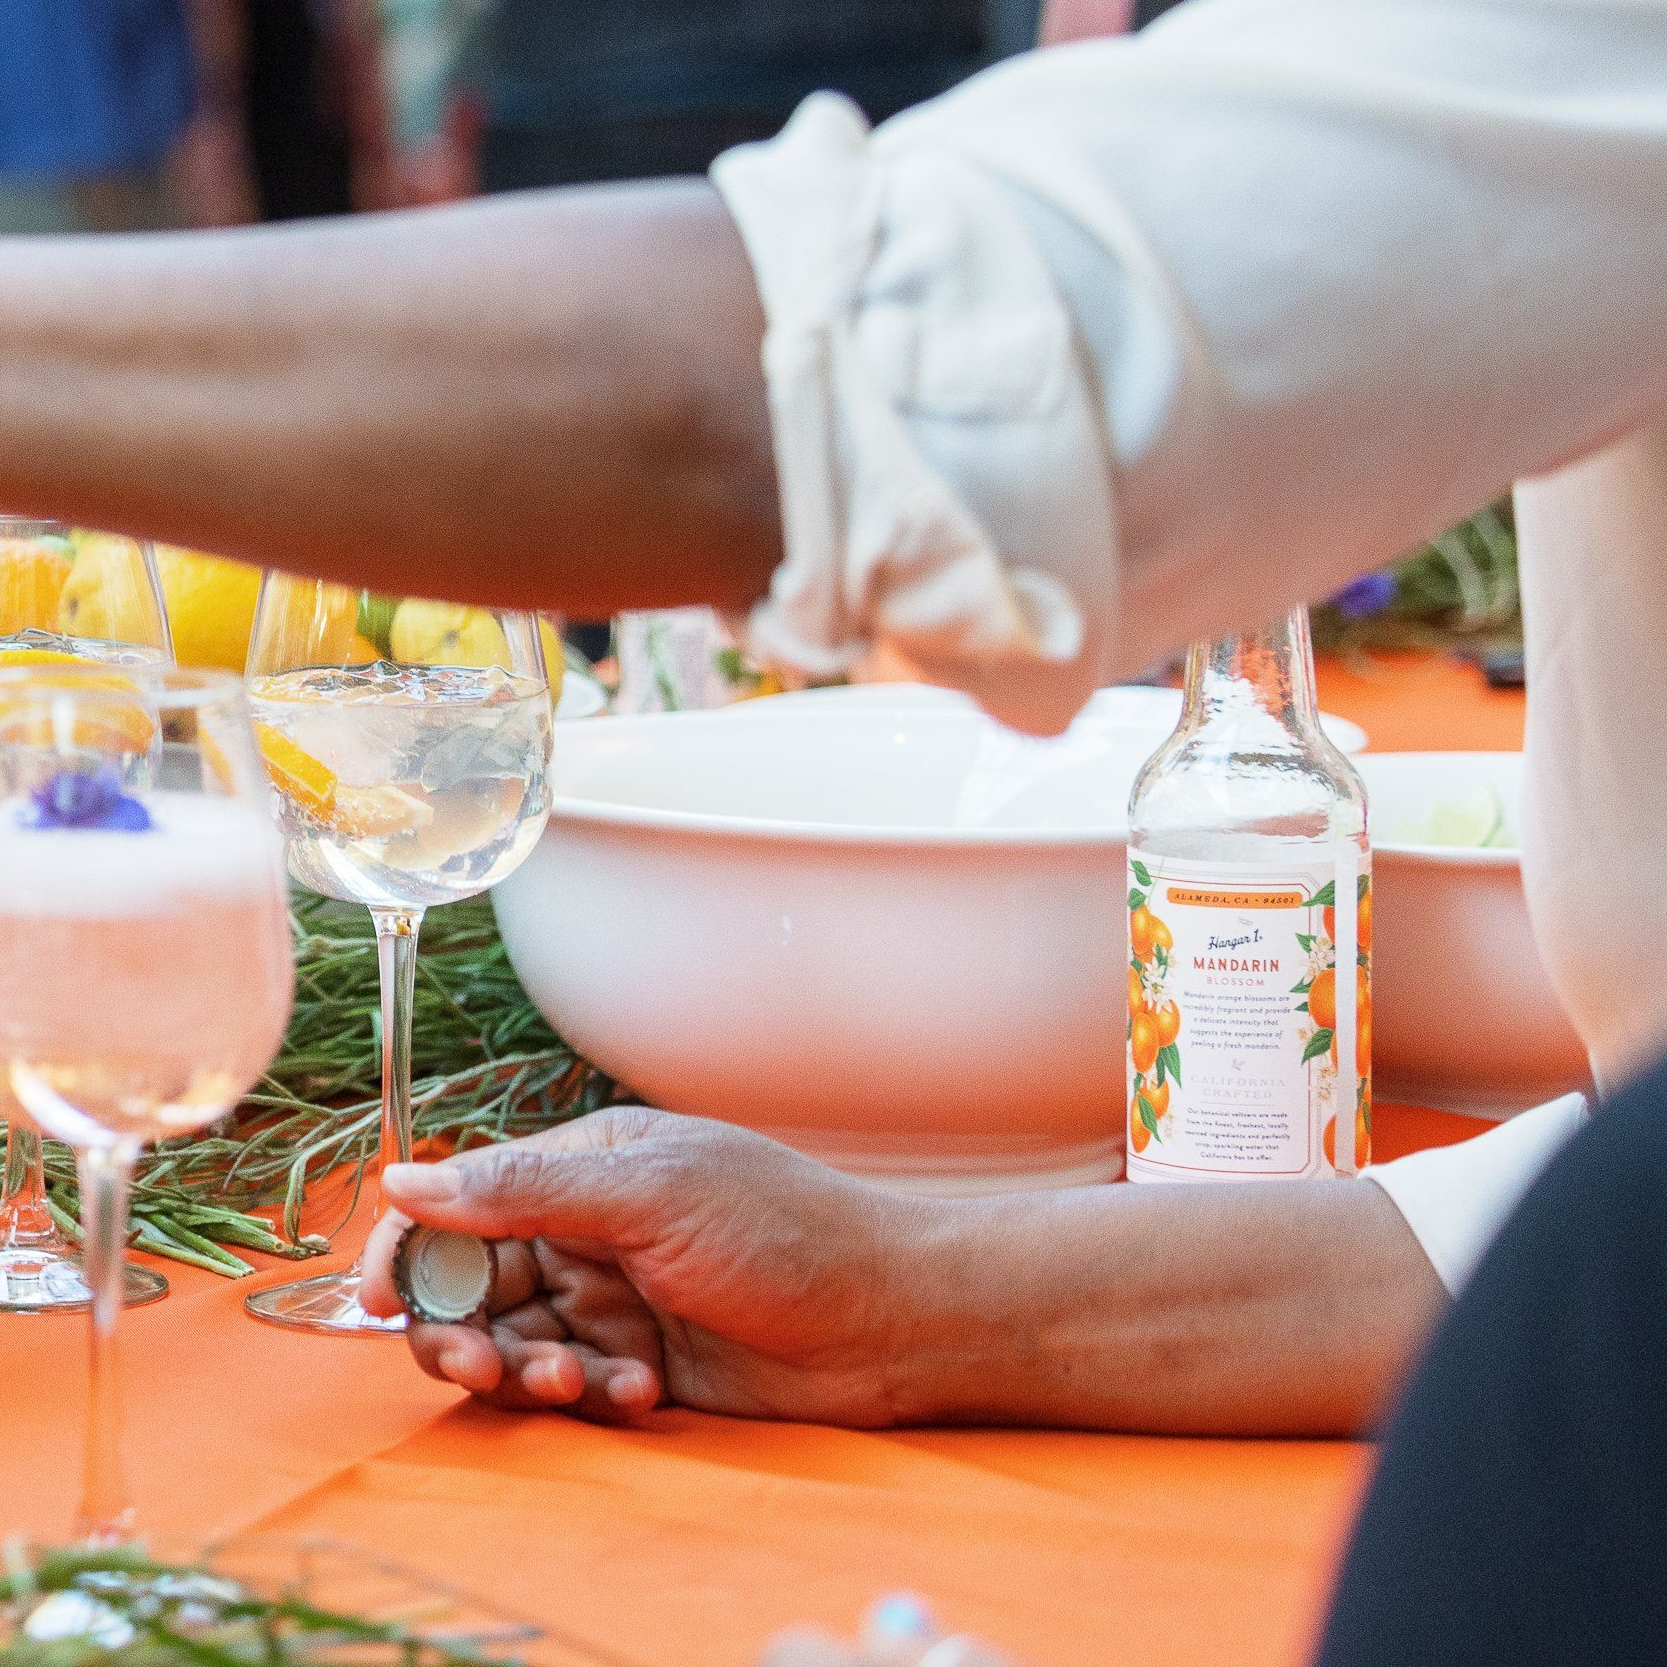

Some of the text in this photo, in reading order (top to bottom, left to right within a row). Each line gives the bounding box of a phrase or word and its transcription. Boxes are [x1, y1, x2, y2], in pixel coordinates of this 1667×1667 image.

[1174, 893, 1230, 903] ALAMEDA,
[1234, 896, 1249, 904] CA
[1208, 935, 1251, 950] Hangar
[1193, 957, 1279, 972] MANDARIN
[1206, 977, 1265, 986] BLOSSOM
[1184, 991, 1215, 999] Mandarin
[1217, 1006, 1247, 1014] fragrant
[1265, 1008, 1291, 1016] provide
[1229, 1018, 1260, 1026] intensity
[1275, 1030, 1283, 1039] of
[1191, 1040, 1215, 1049] peeling
[1223, 1042, 1243, 1050] fresh
[1191, 1075, 1286, 1087] CALIFORNIA
[1202, 1089, 1273, 1099] CRAFTED
[1201, 1108, 1229, 1117] botanical
[1200, 1152, 1232, 1160] California
